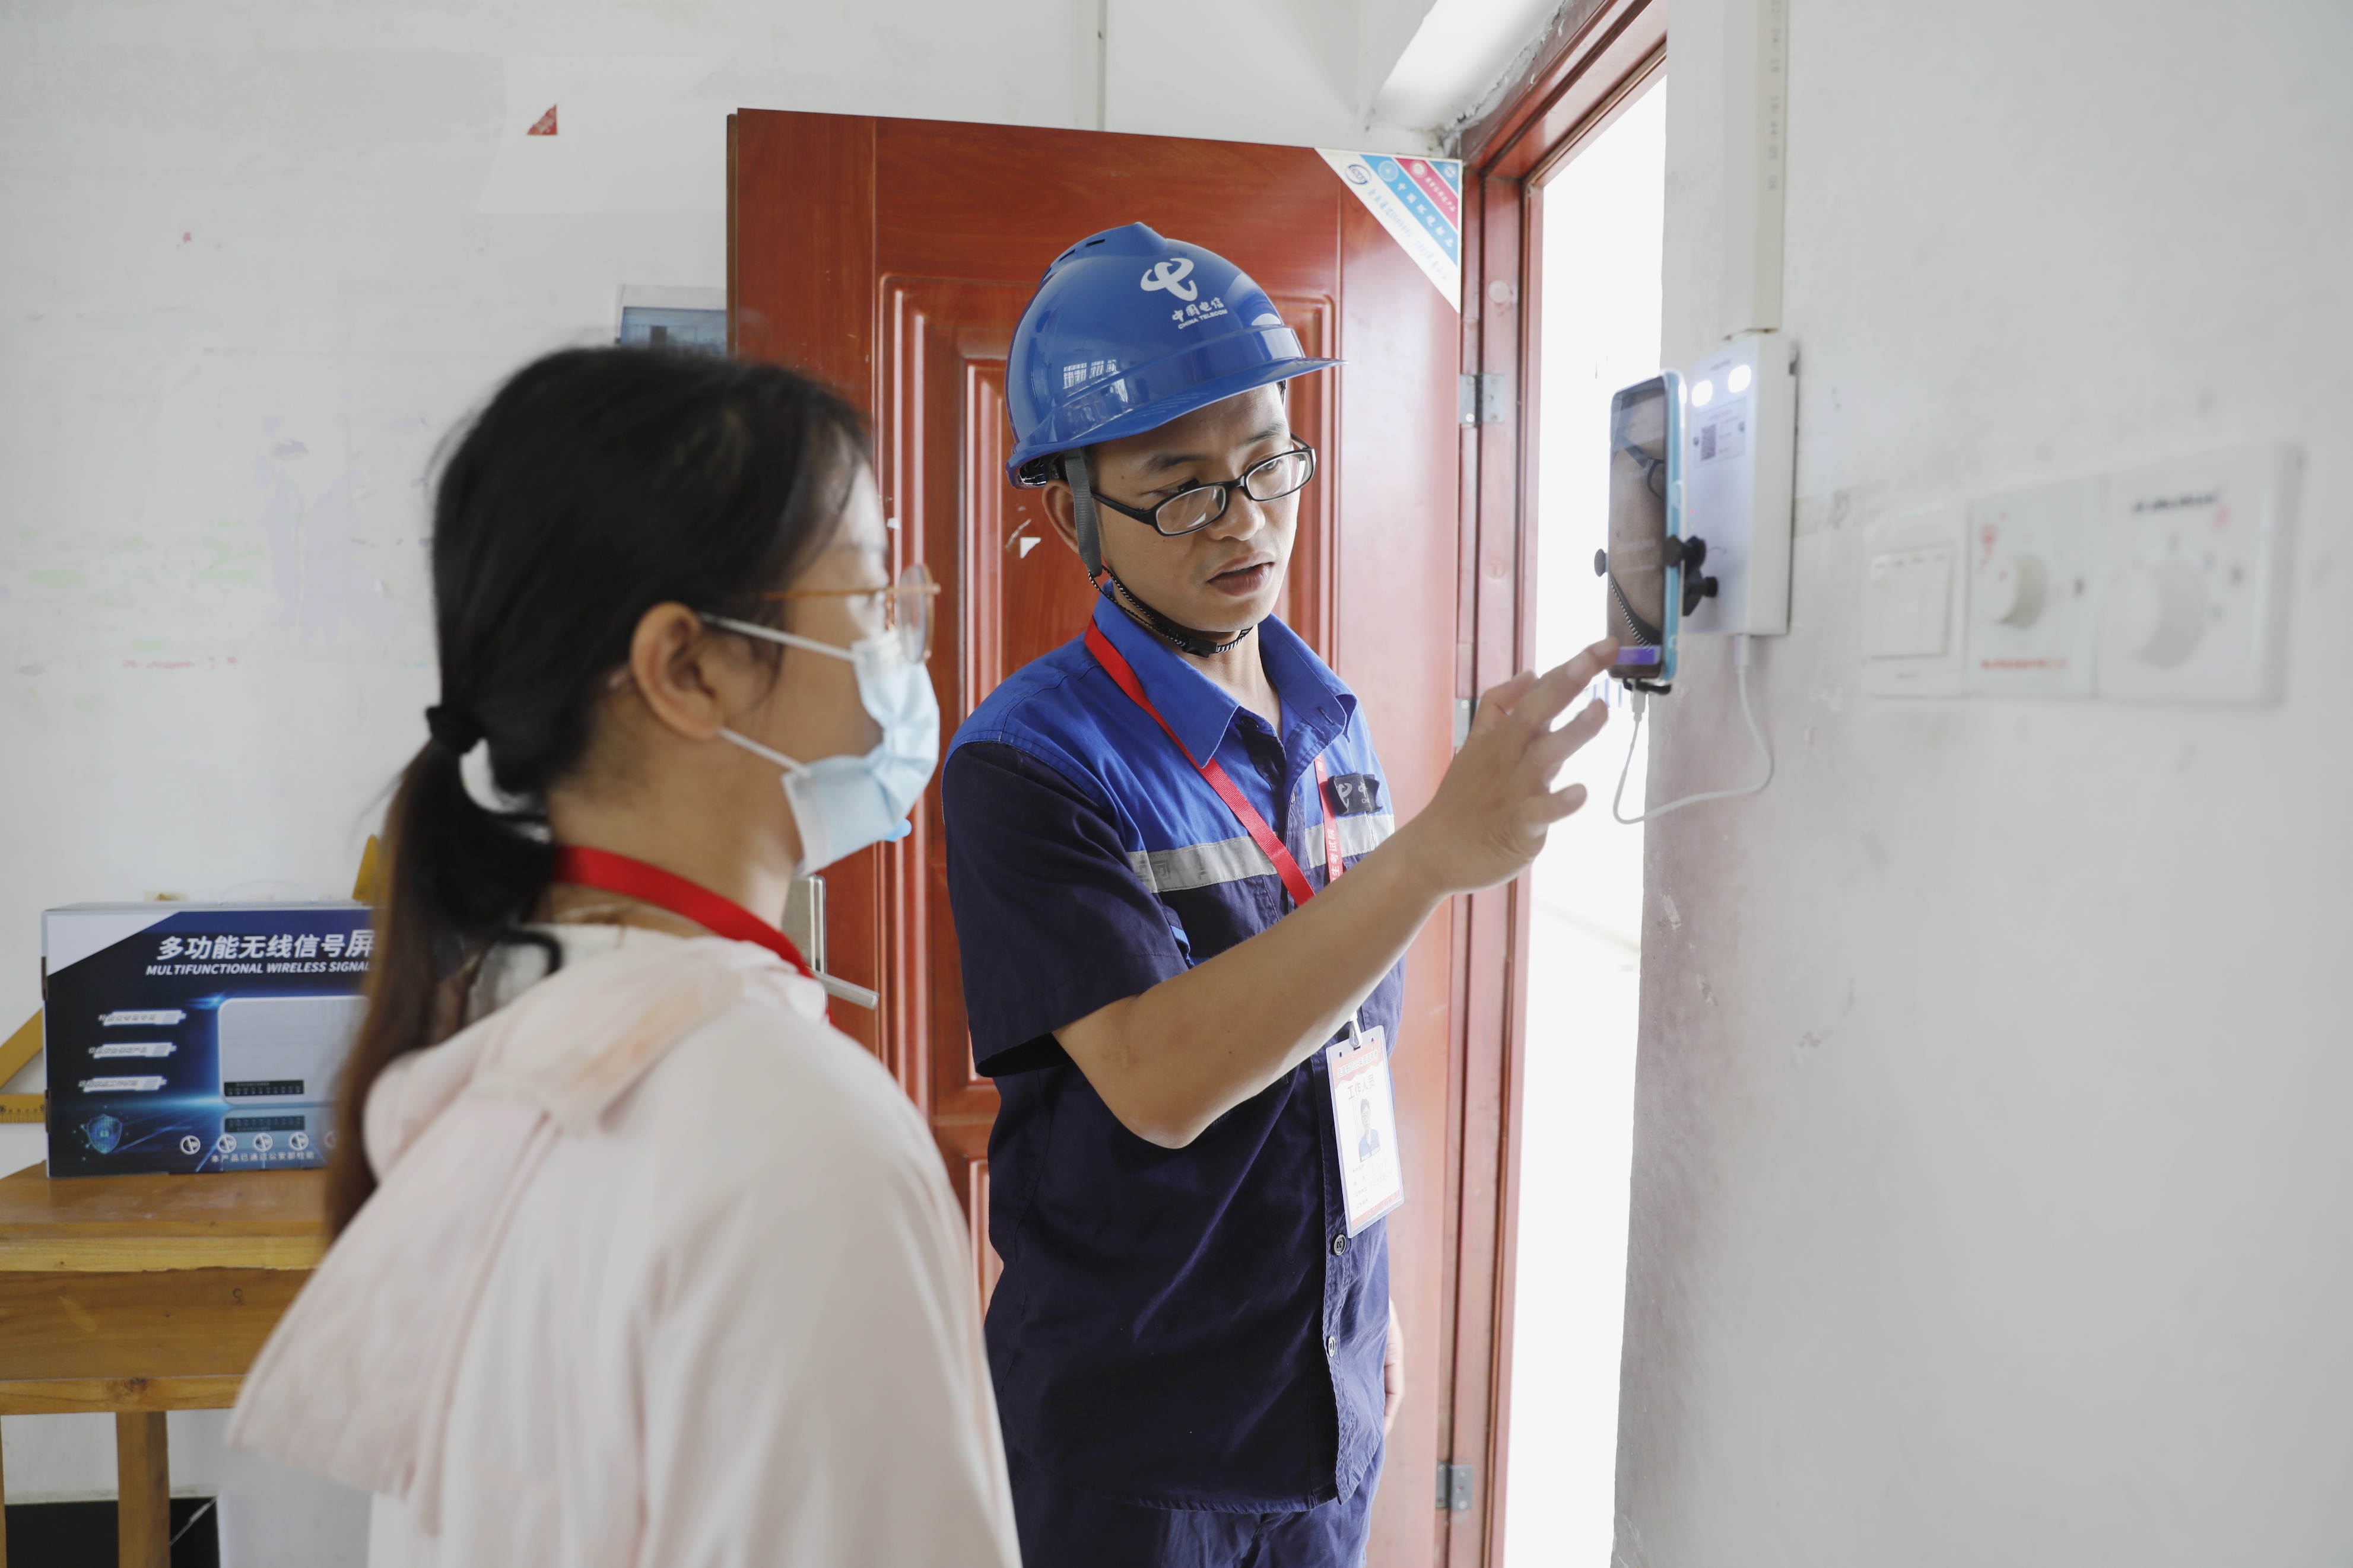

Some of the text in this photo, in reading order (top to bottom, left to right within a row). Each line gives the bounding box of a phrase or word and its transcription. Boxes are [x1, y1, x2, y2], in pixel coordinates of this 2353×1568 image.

[1171, 297, 1224, 323] 中国电信
[1177, 309, 1228, 330] CHINA TELECOM
[1326, 828, 1340, 881] 生考试院
[156, 928, 374, 961] 多功能无线信号屏
[145, 962, 263, 976] MULTIFUNCTIONAL
[266, 961, 326, 974] WIRELESS
[1347, 1074, 1375, 1100] 工作人员
